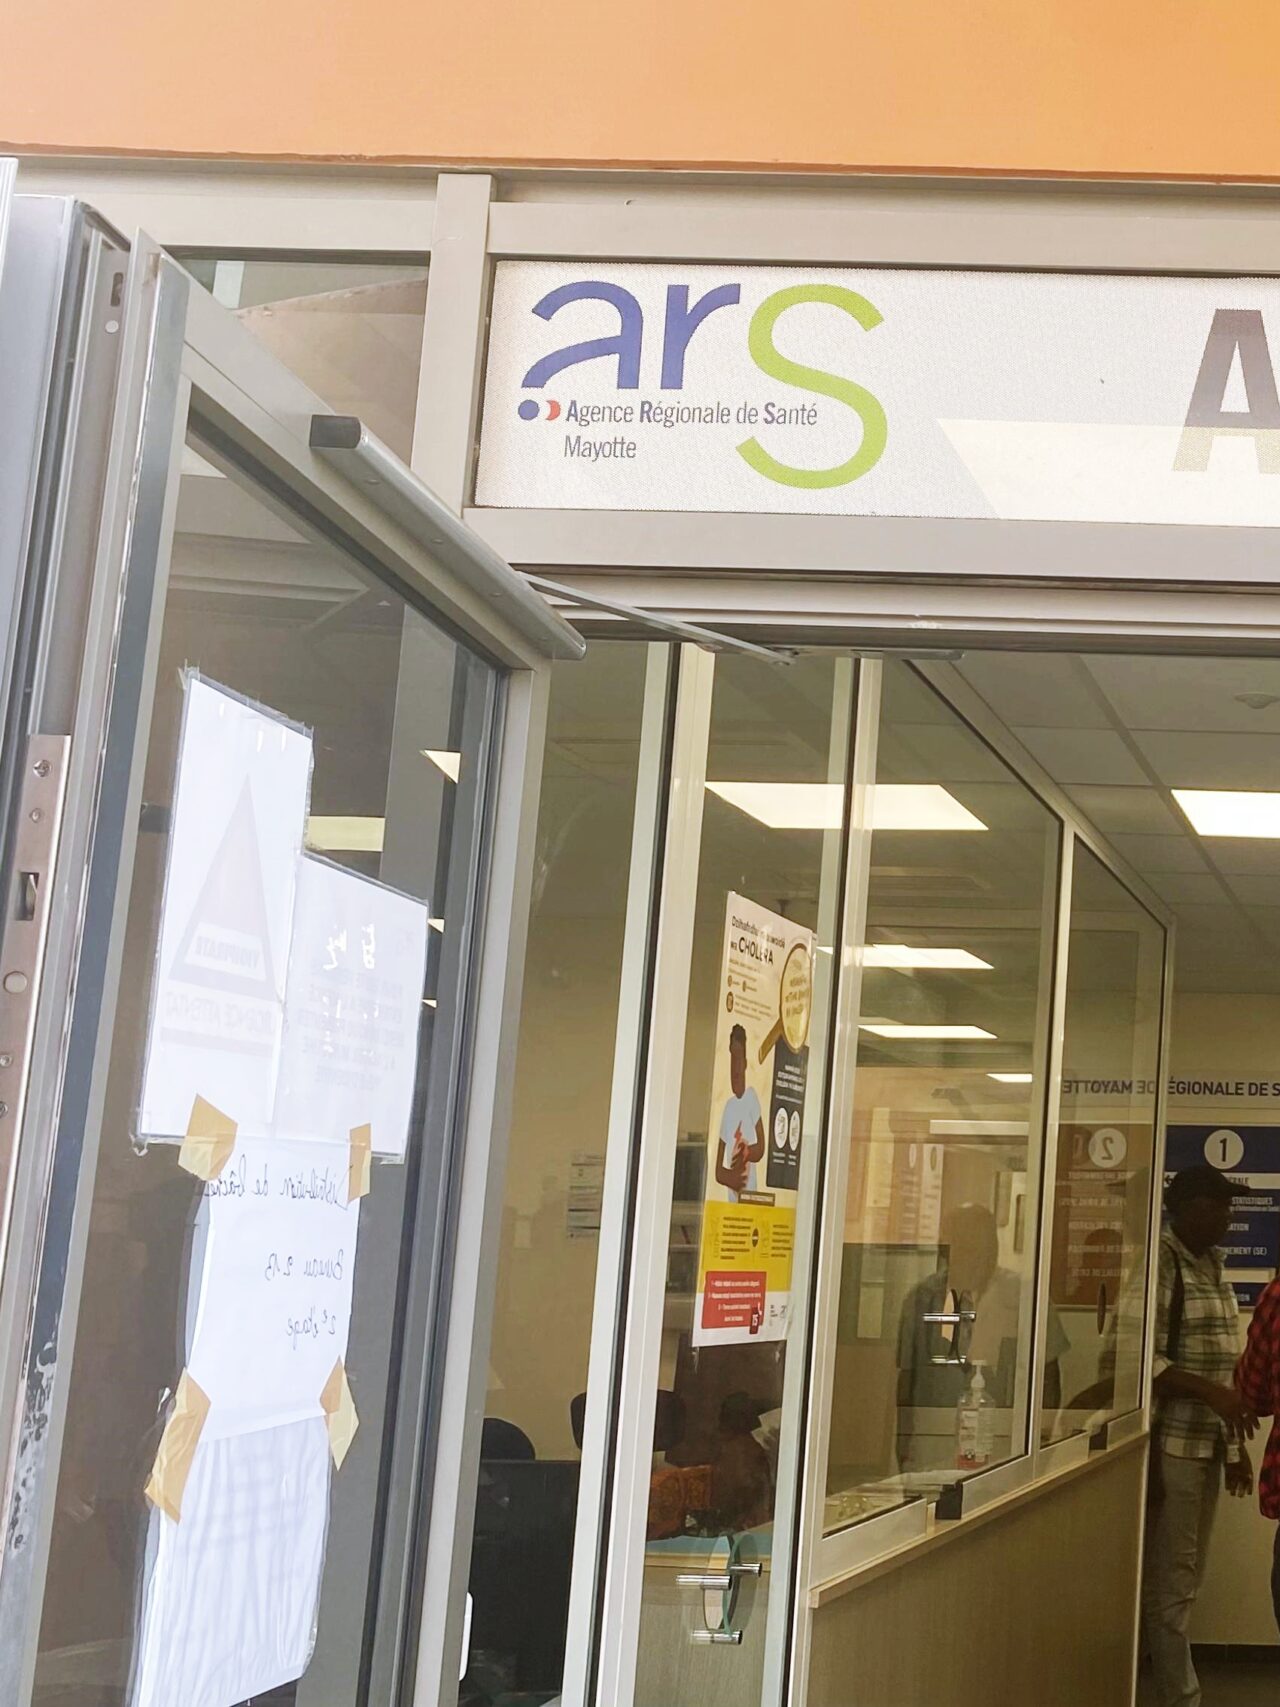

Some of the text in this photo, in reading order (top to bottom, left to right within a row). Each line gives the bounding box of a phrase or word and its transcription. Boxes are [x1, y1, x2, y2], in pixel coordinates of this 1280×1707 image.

[565, 400, 817, 428] Agence Régionale de Santé
[564, 435, 637, 462] Mayotte
[1167, 1075, 1244, 1097] ÉGIONALE
[1249, 1082, 1268, 1096] DE
[1218, 1138, 1227, 1162] 1
